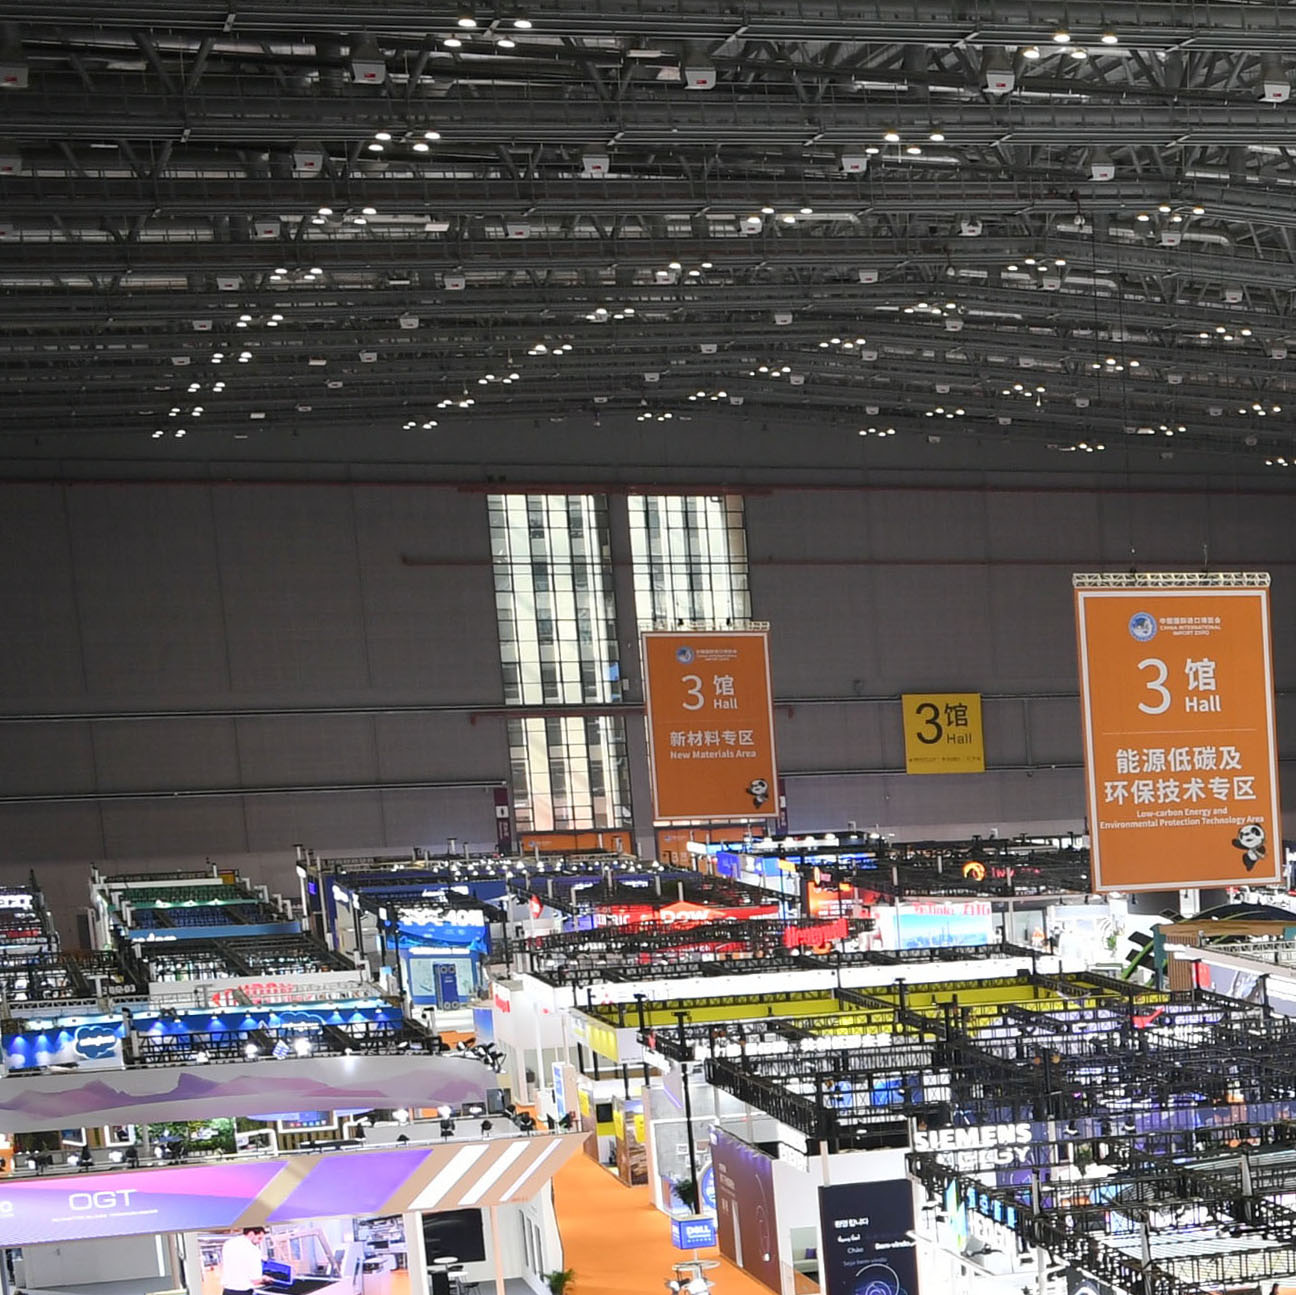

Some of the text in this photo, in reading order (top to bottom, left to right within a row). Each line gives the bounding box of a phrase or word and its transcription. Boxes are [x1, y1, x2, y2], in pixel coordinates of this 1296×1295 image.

[713, 674, 735, 696] 馆
[1184, 658, 1217, 692] 馆
[681, 675, 705, 711] 3
[1137, 658, 1172, 715] 3
[713, 699, 738, 710] Hall
[944, 702, 968, 727] 馆
[1185, 696, 1222, 713] Hall
[916, 702, 943, 744] 3
[670, 730, 754, 746] 新材料专区
[947, 733, 972, 745] Hall
[670, 749, 757, 760] New Materials Area
[1115, 746, 1242, 774] 能源低碳及
[1104, 776, 1257, 805] 环保技术专区
[1100, 815, 1265, 829] Environmental Protection Technology Area
[1136, 806, 1228, 818] Low-carbon Energy and
[914, 1123, 1033, 1152] SIEMENS
[69, 1189, 137, 1211] OGT
